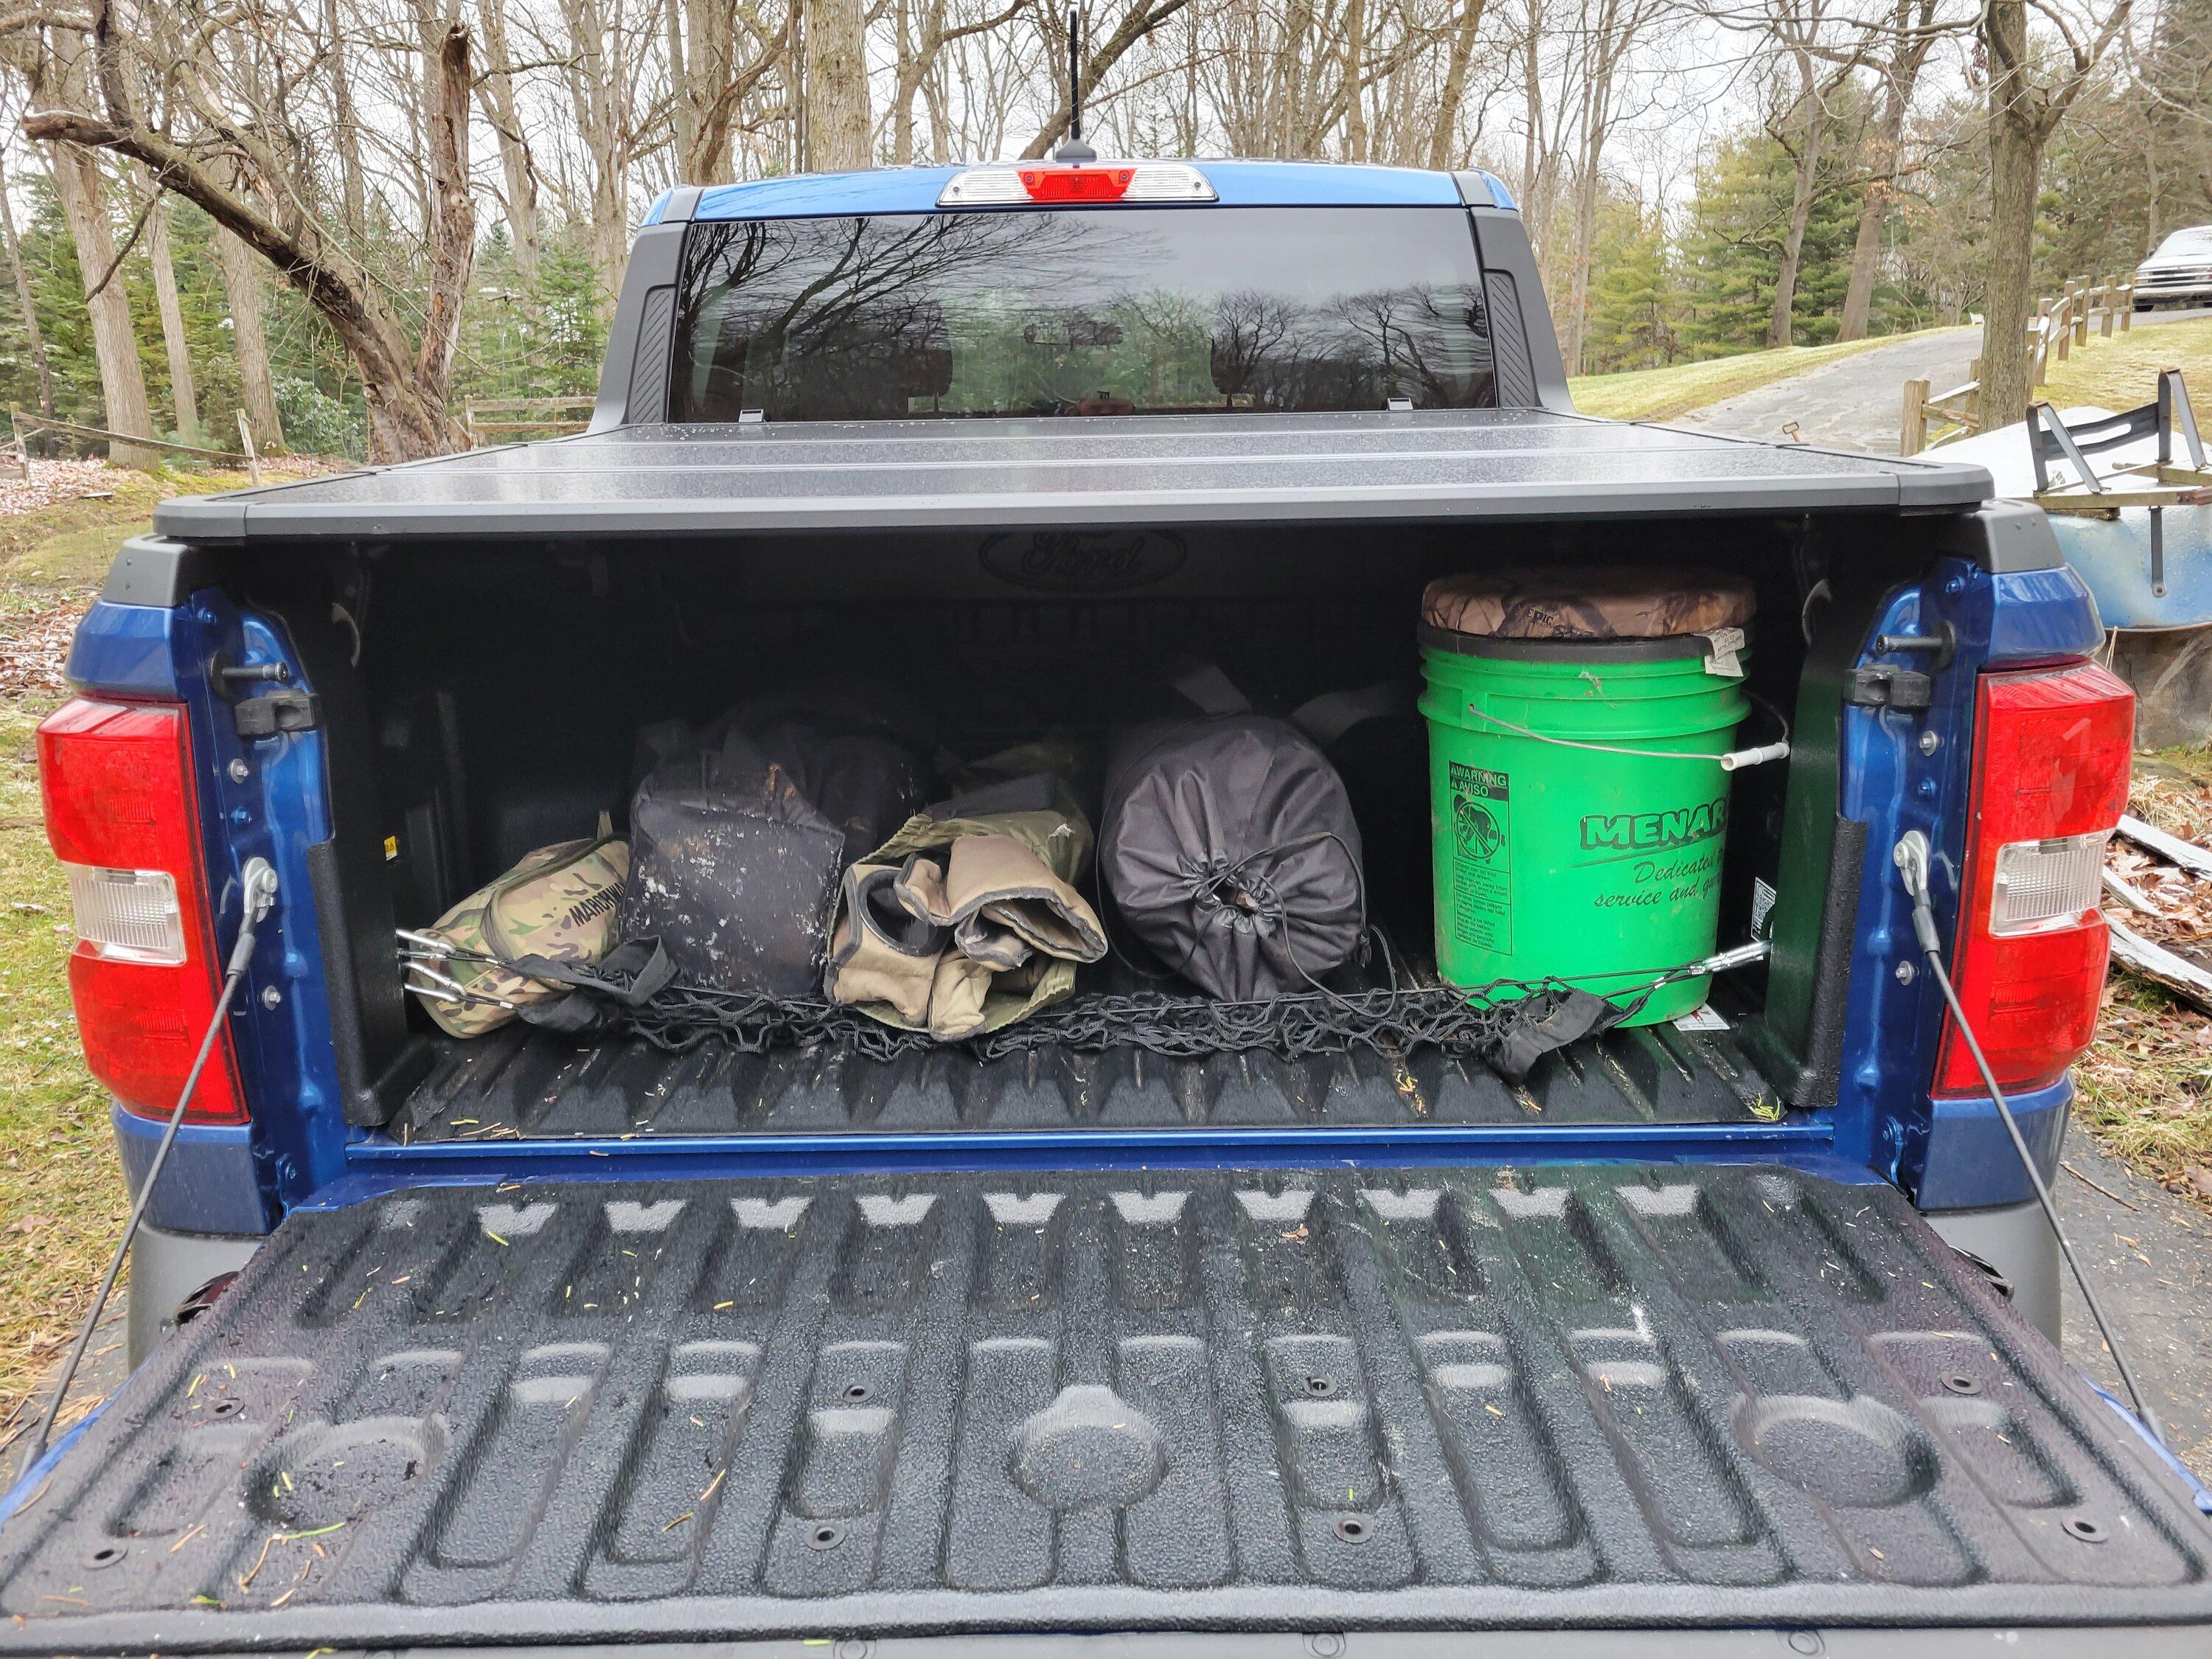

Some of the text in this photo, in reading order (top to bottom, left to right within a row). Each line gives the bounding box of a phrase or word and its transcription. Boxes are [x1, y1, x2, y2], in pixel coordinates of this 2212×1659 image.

[1020, 532, 1145, 577] Ford
[1455, 765, 1507, 787] WARNING
[1459, 780, 1489, 797] AVISO
[1582, 798, 1726, 849] MENAR
[568, 882, 624, 928] MARCHWA
[1593, 890, 1663, 908] service
[1669, 876, 1700, 902] and
